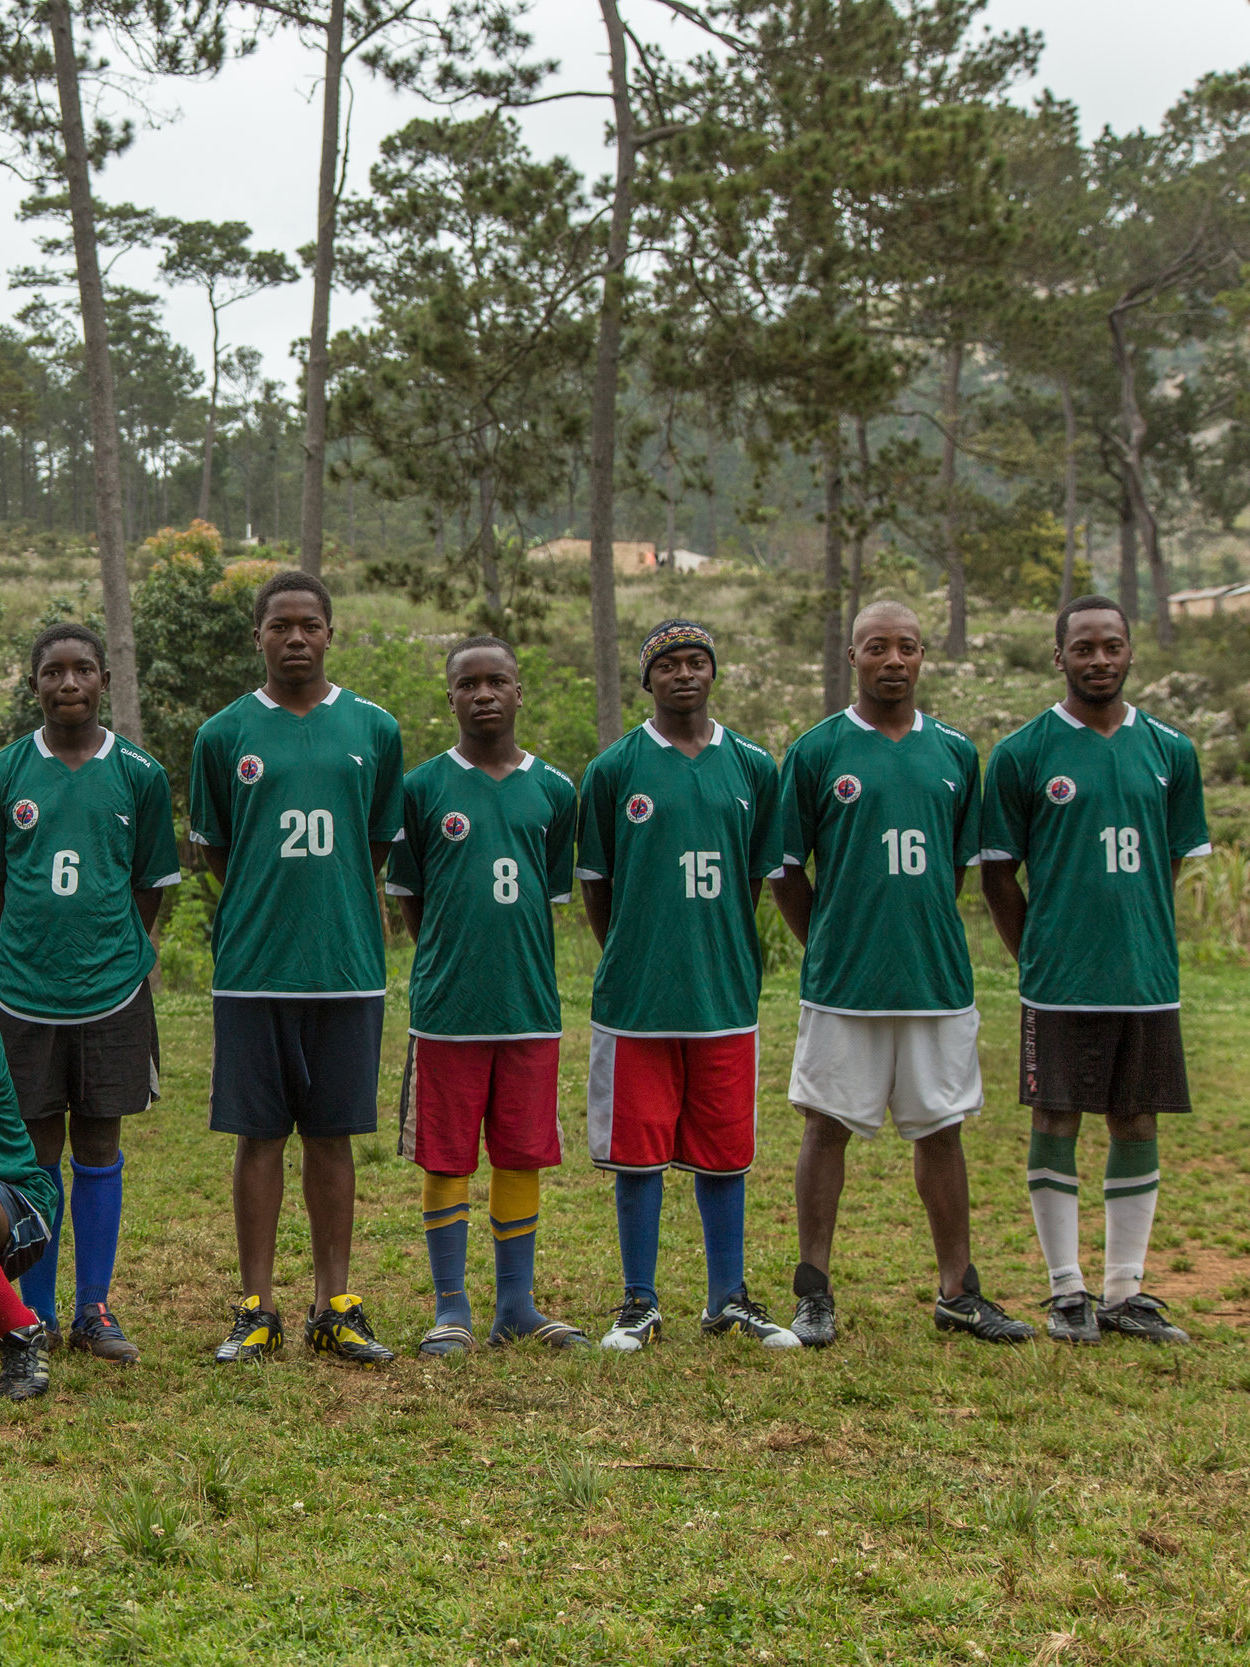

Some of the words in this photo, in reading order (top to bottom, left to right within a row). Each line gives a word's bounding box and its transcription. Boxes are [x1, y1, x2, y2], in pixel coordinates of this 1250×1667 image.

[120, 748, 151, 768] DIADORA
[735, 737, 767, 757] DIADORA
[281, 810, 333, 857] 20
[883, 829, 927, 875] 16
[1101, 828, 1141, 873] 18
[52, 850, 80, 896] 6
[493, 858, 519, 904] 8
[680, 852, 721, 899] 15
